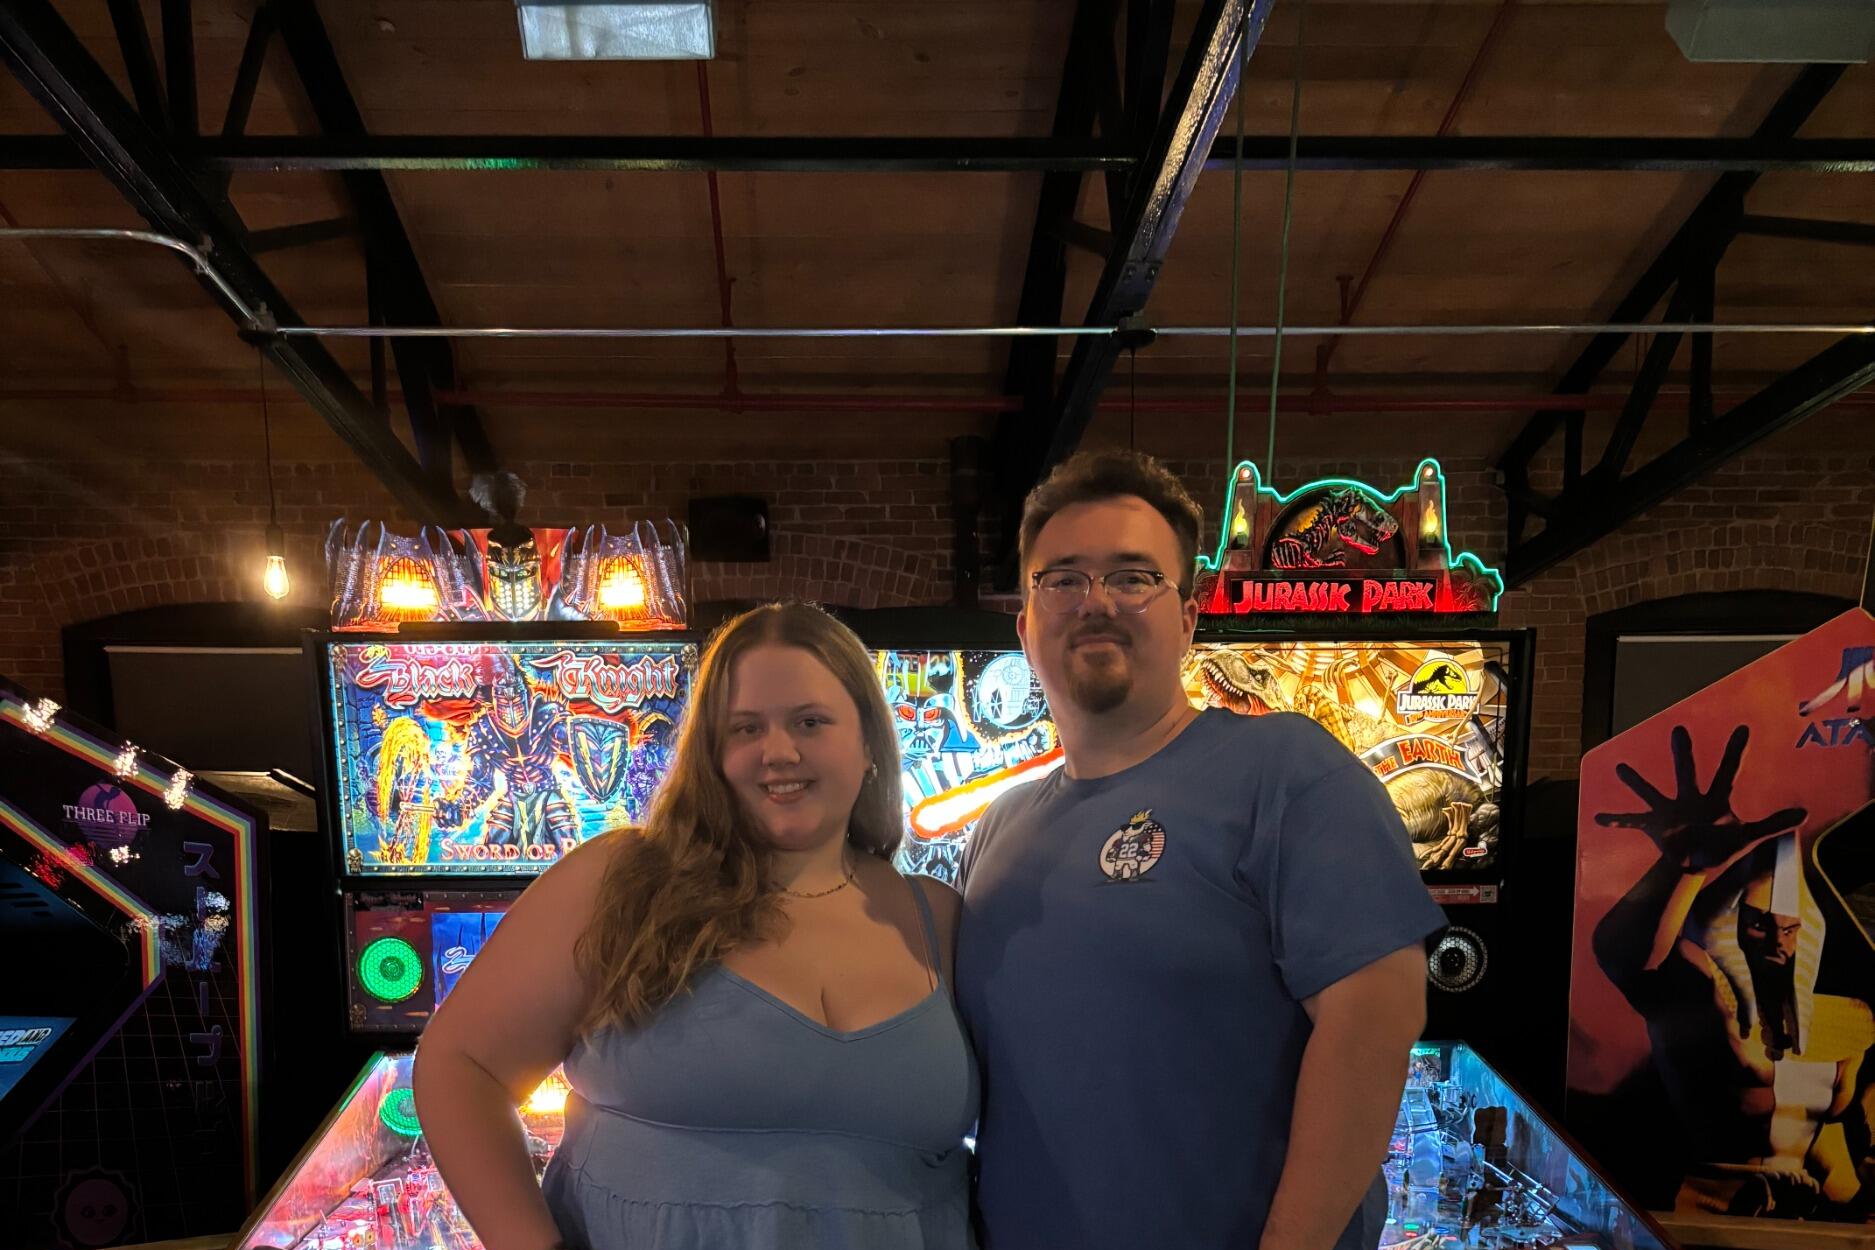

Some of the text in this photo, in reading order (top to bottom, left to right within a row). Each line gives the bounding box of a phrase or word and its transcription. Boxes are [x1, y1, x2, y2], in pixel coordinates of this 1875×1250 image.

[1234, 579, 1433, 613] JURASSIC PARK
[356, 651, 680, 713] Black Knight
[1399, 693, 1446, 711] JURASSIC
[1374, 739, 1466, 776] THE EARTH
[62, 804, 151, 826] THREE FLIP
[441, 838, 520, 861] SWORD
[1119, 842, 1139, 858] 22
